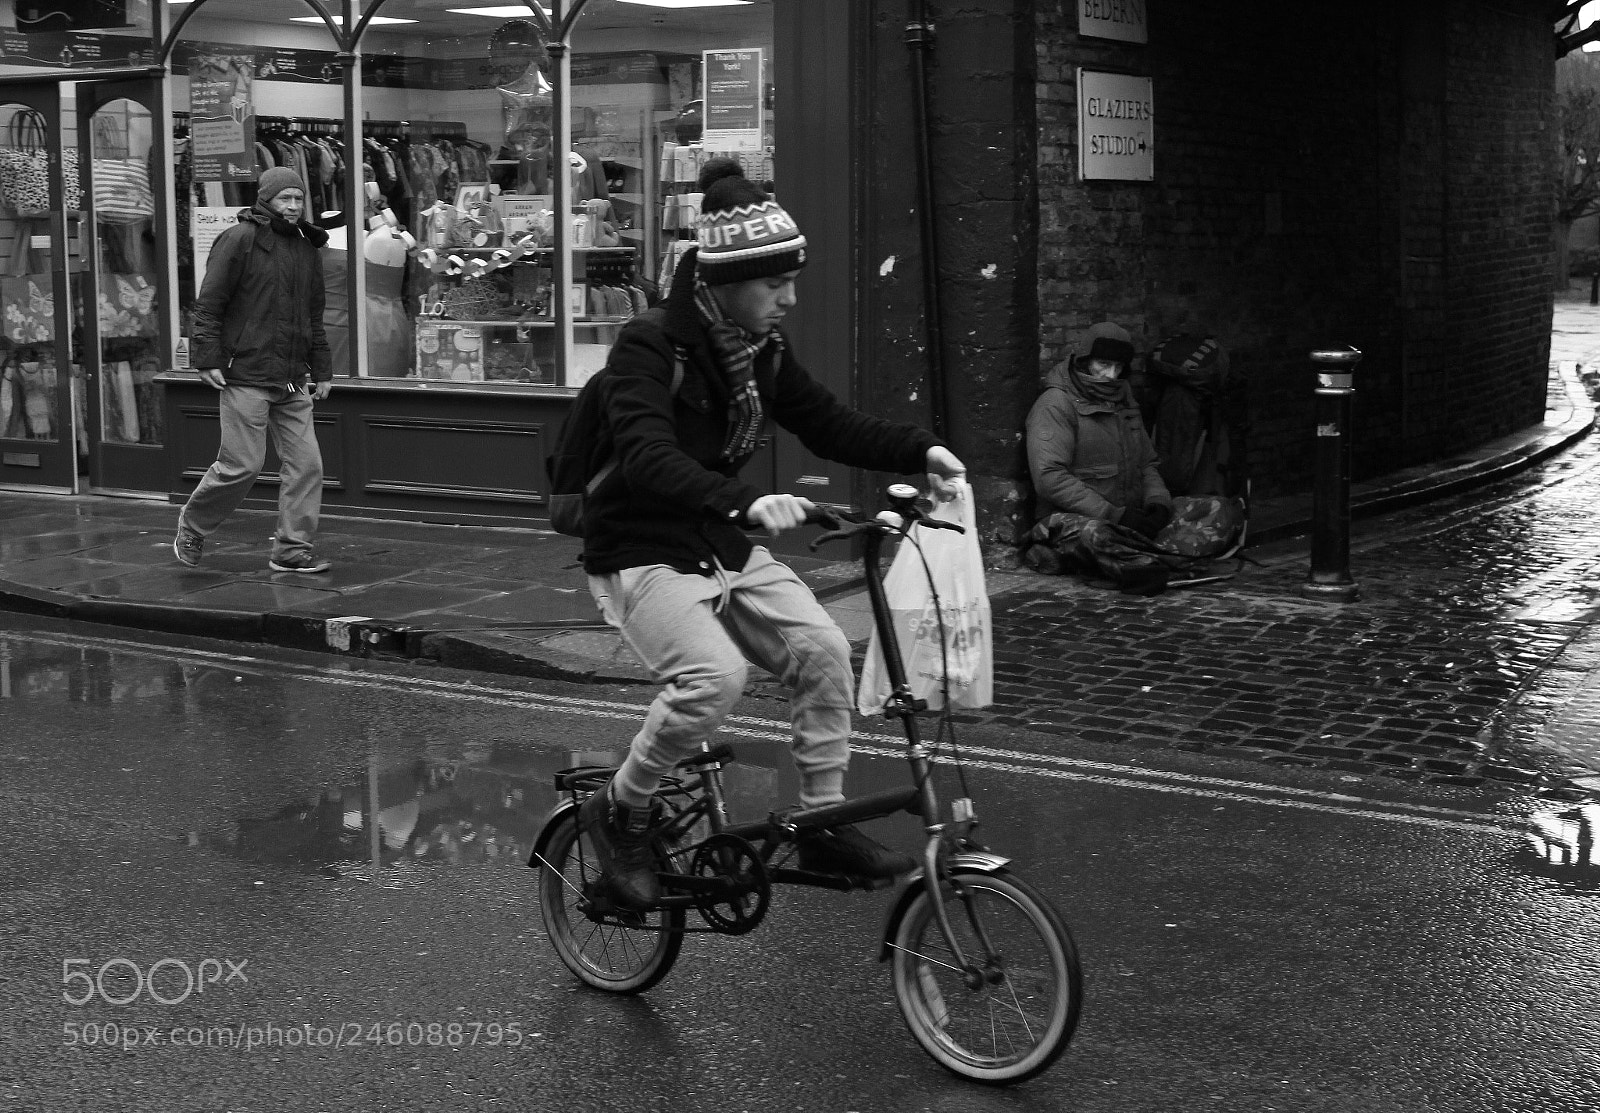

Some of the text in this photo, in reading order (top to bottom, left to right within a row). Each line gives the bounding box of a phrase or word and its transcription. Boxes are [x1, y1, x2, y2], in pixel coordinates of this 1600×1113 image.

[1085, 0, 1143, 24] BEDERN
[714, 52, 752, 61] Thank You
[1088, 97, 1151, 120] GLAZIERS
[1091, 135, 1136, 156] STUDIO
